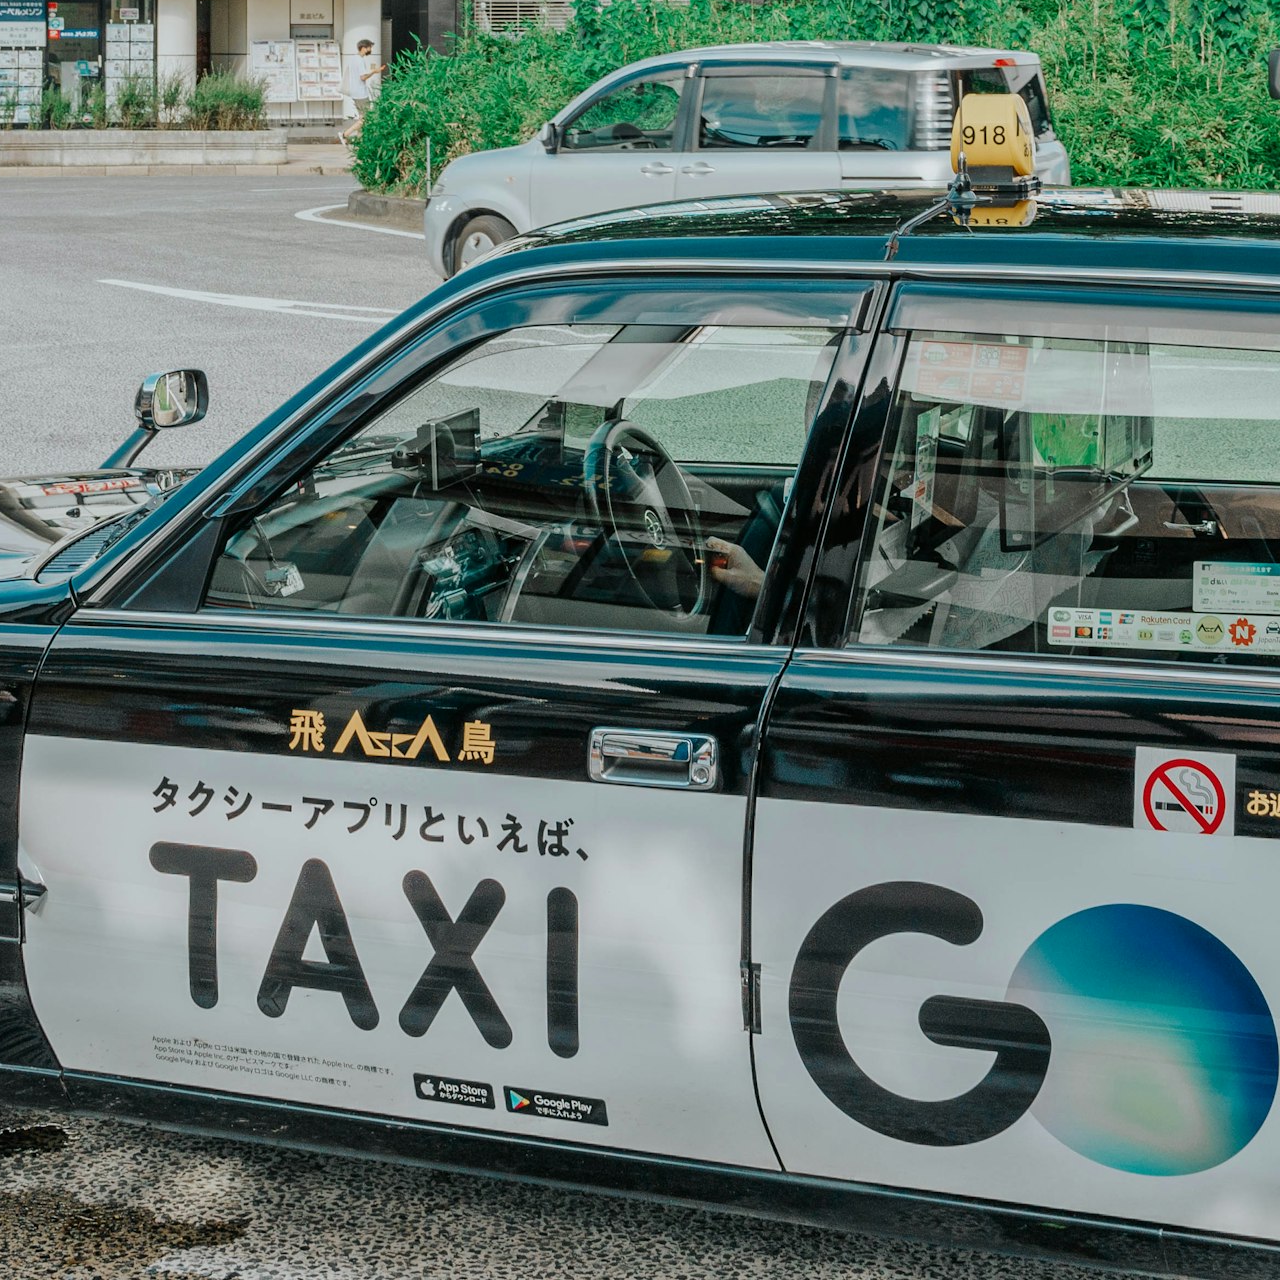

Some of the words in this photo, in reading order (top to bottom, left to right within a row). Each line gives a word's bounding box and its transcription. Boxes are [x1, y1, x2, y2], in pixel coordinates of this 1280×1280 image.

[963, 125, 1006, 145] 918
[1141, 615, 1171, 625] Rakuten
[1173, 617, 1191, 625] Card
[151, 776, 591, 862] タクシーアプリといえば、
[149, 840, 579, 1059] TAXI
[152, 1035, 171, 1045] Apple
[322, 1059, 342, 1070] Apple
[153, 1044, 168, 1054] App
[194, 1050, 213, 1060] Apple
[155, 1053, 179, 1065] Google
[180, 1057, 194, 1066] Play
[214, 1061, 238, 1073] Google
[239, 1065, 253, 1075] Play
[275, 1070, 300, 1081] Google
[439, 1080, 461, 1097] App
[462, 1084, 488, 1098] Store
[439, 1091, 488, 1105] からダウンロード
[533, 1094, 569, 1113] Google
[570, 1098, 593, 1115] Play
[535, 1107, 584, 1121] で手に入れよう
